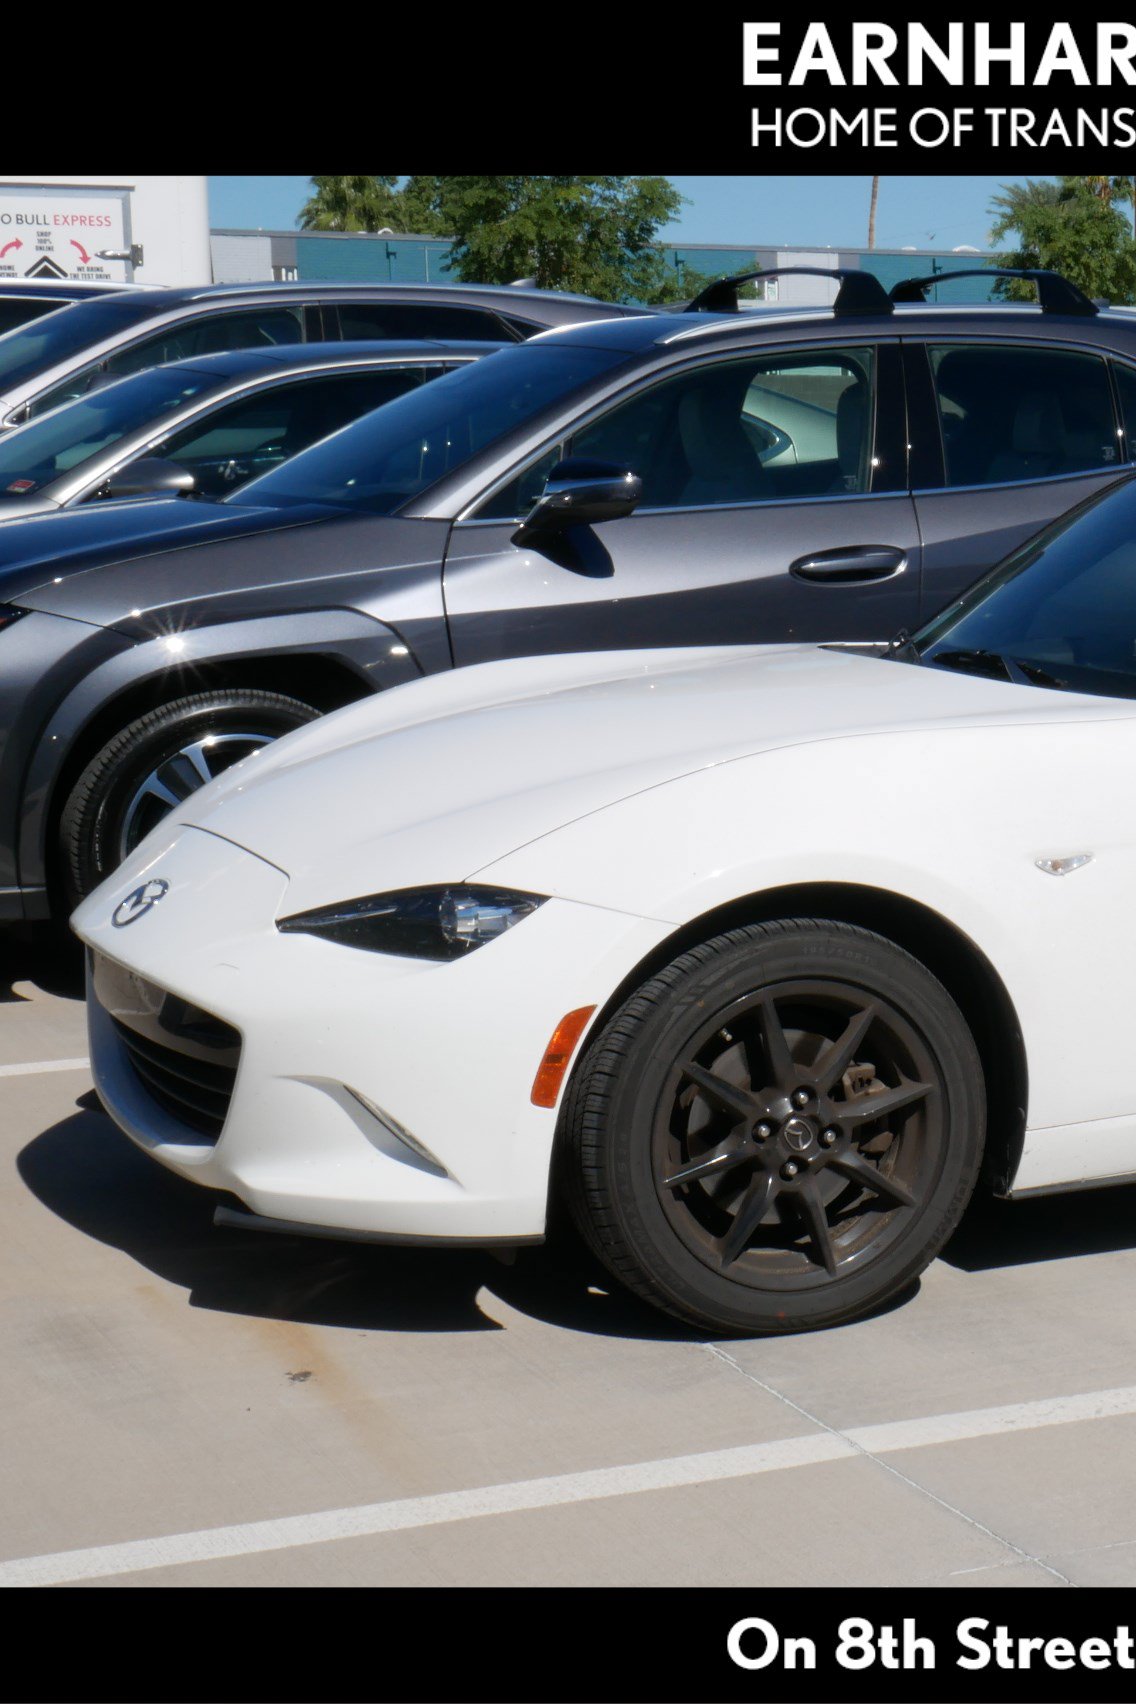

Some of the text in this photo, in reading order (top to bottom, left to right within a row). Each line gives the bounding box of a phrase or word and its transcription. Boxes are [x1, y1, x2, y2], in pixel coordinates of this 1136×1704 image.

[0, 213, 112, 227] O BULL EXPRESS
